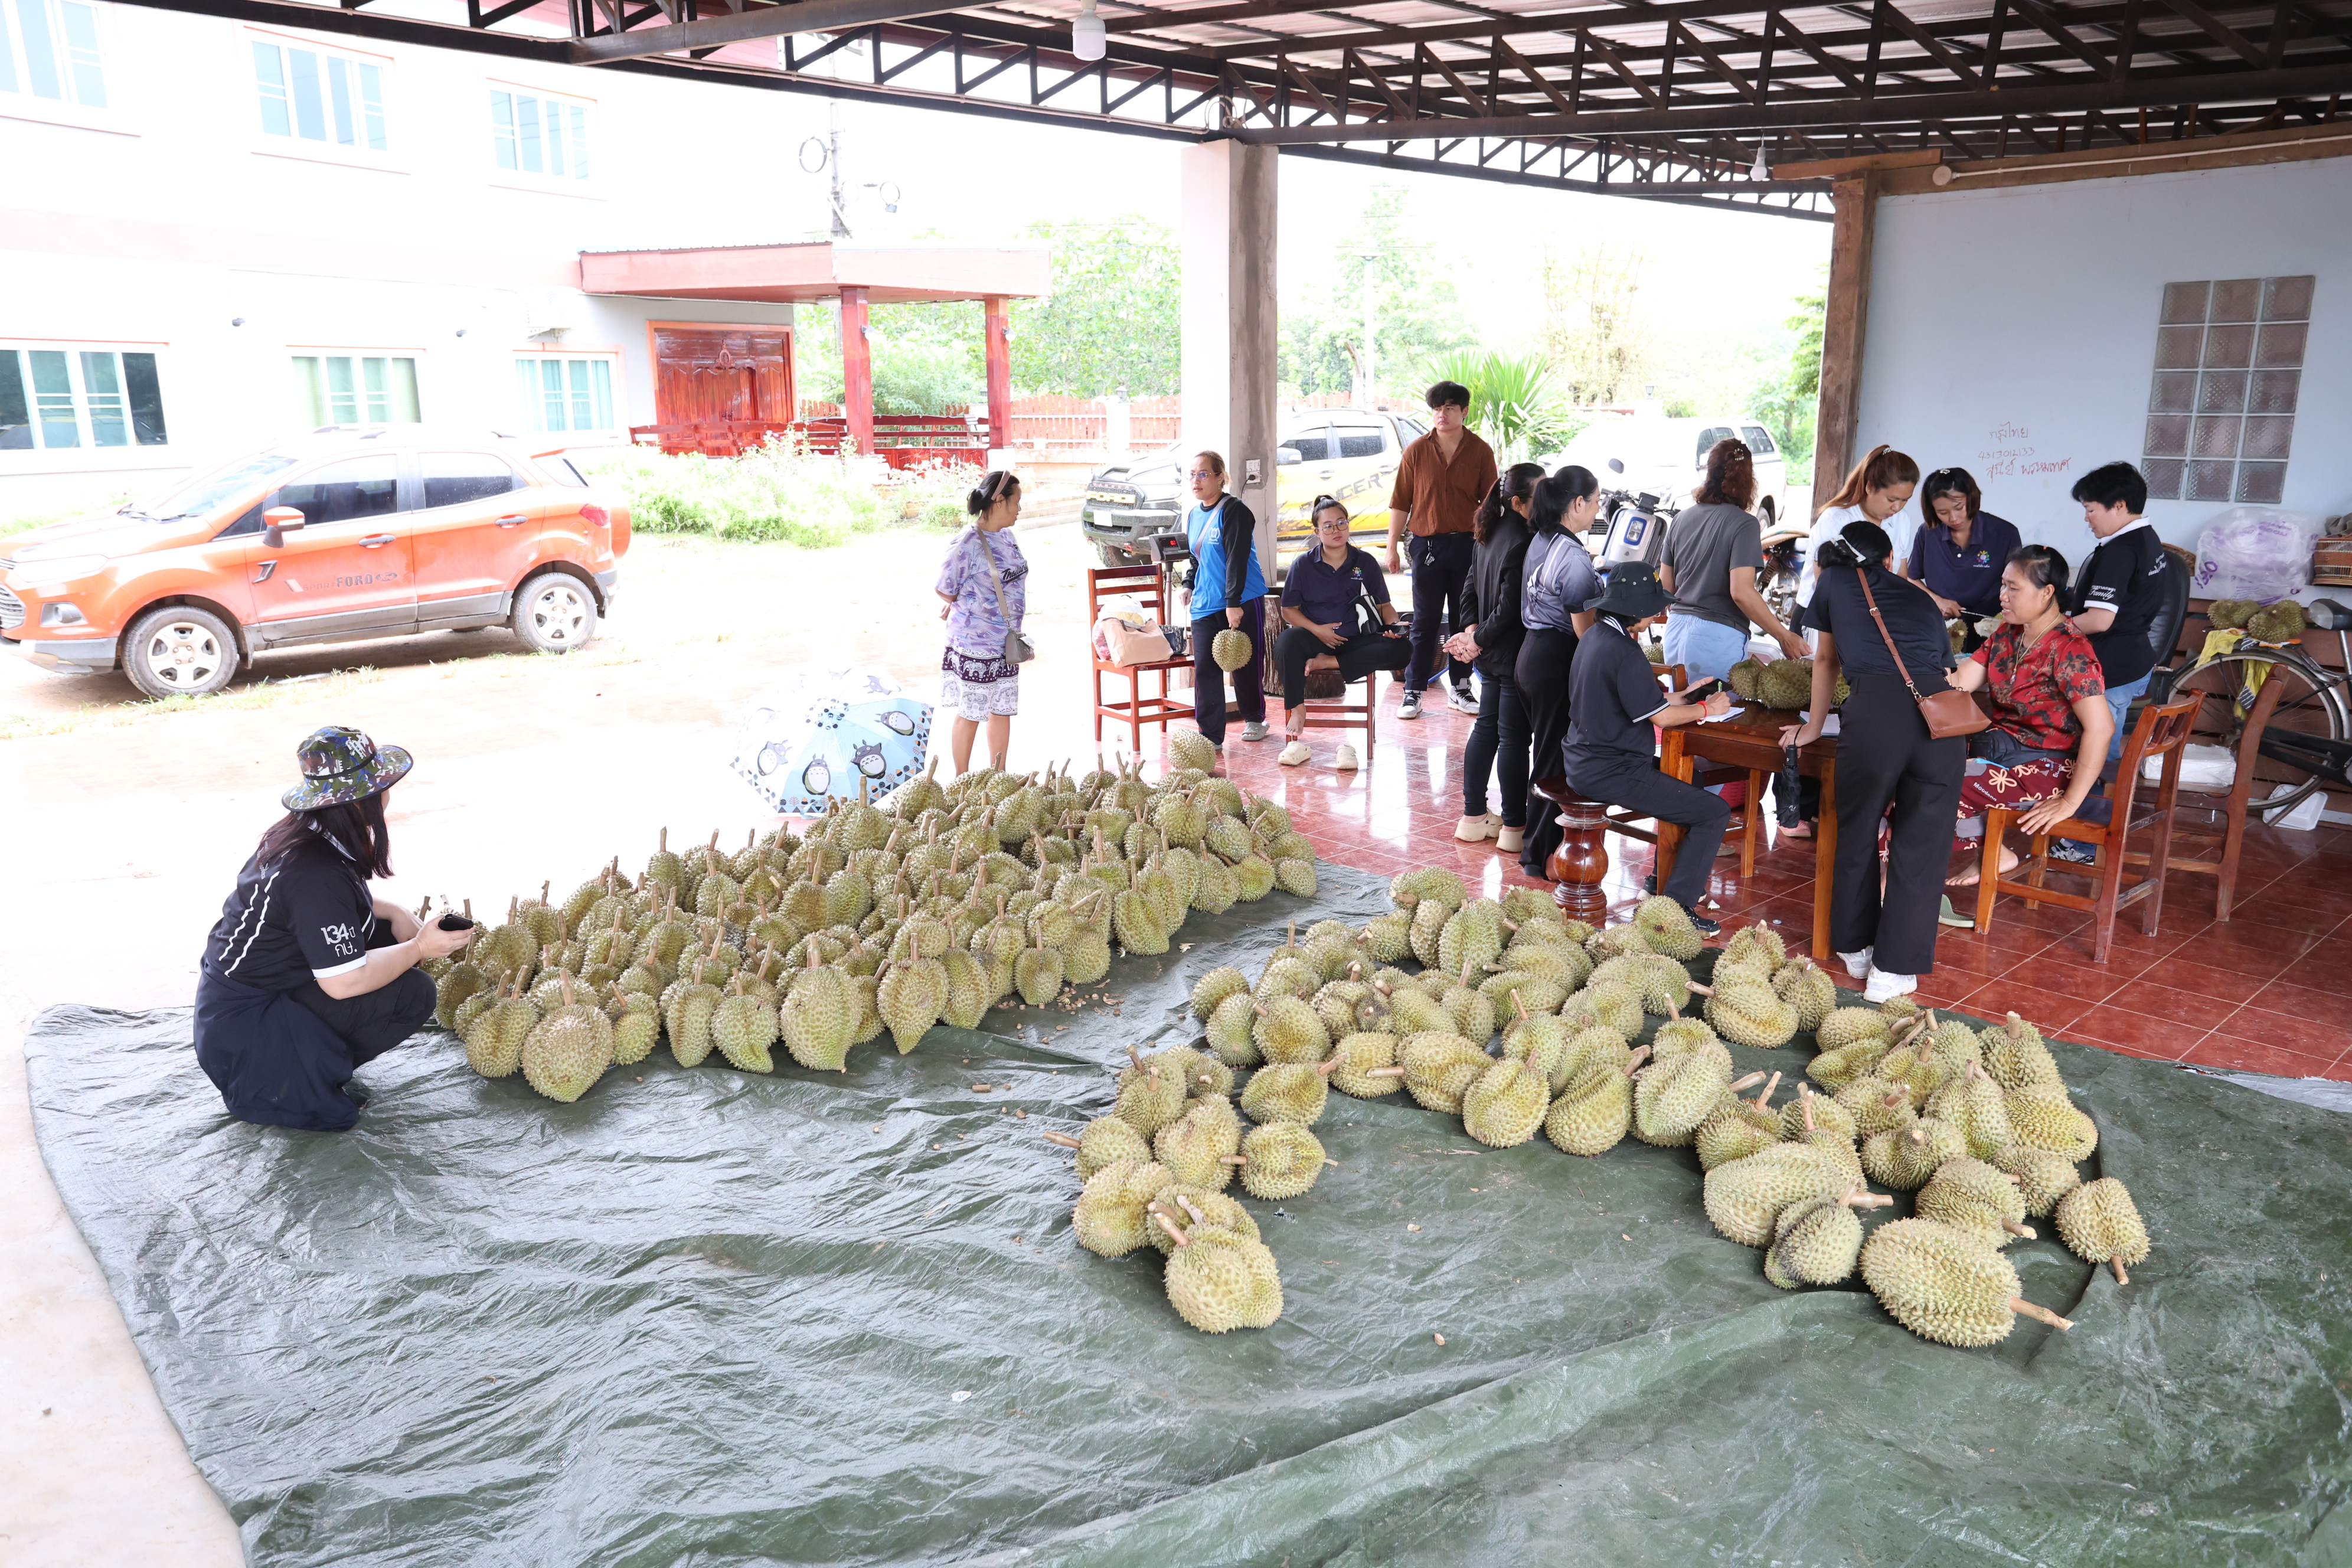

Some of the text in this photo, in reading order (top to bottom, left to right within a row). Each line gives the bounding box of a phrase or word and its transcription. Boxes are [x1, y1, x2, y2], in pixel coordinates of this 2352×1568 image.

[1990, 422, 2028, 443] กรุงไทย
[1978, 447, 2035, 460] 4313012133
[1086, 491, 1135, 504] FORD
[1299, 473, 1383, 518] RNGER
[336, 574, 373, 587] FORD
[2089, 588, 2114, 600] Family
